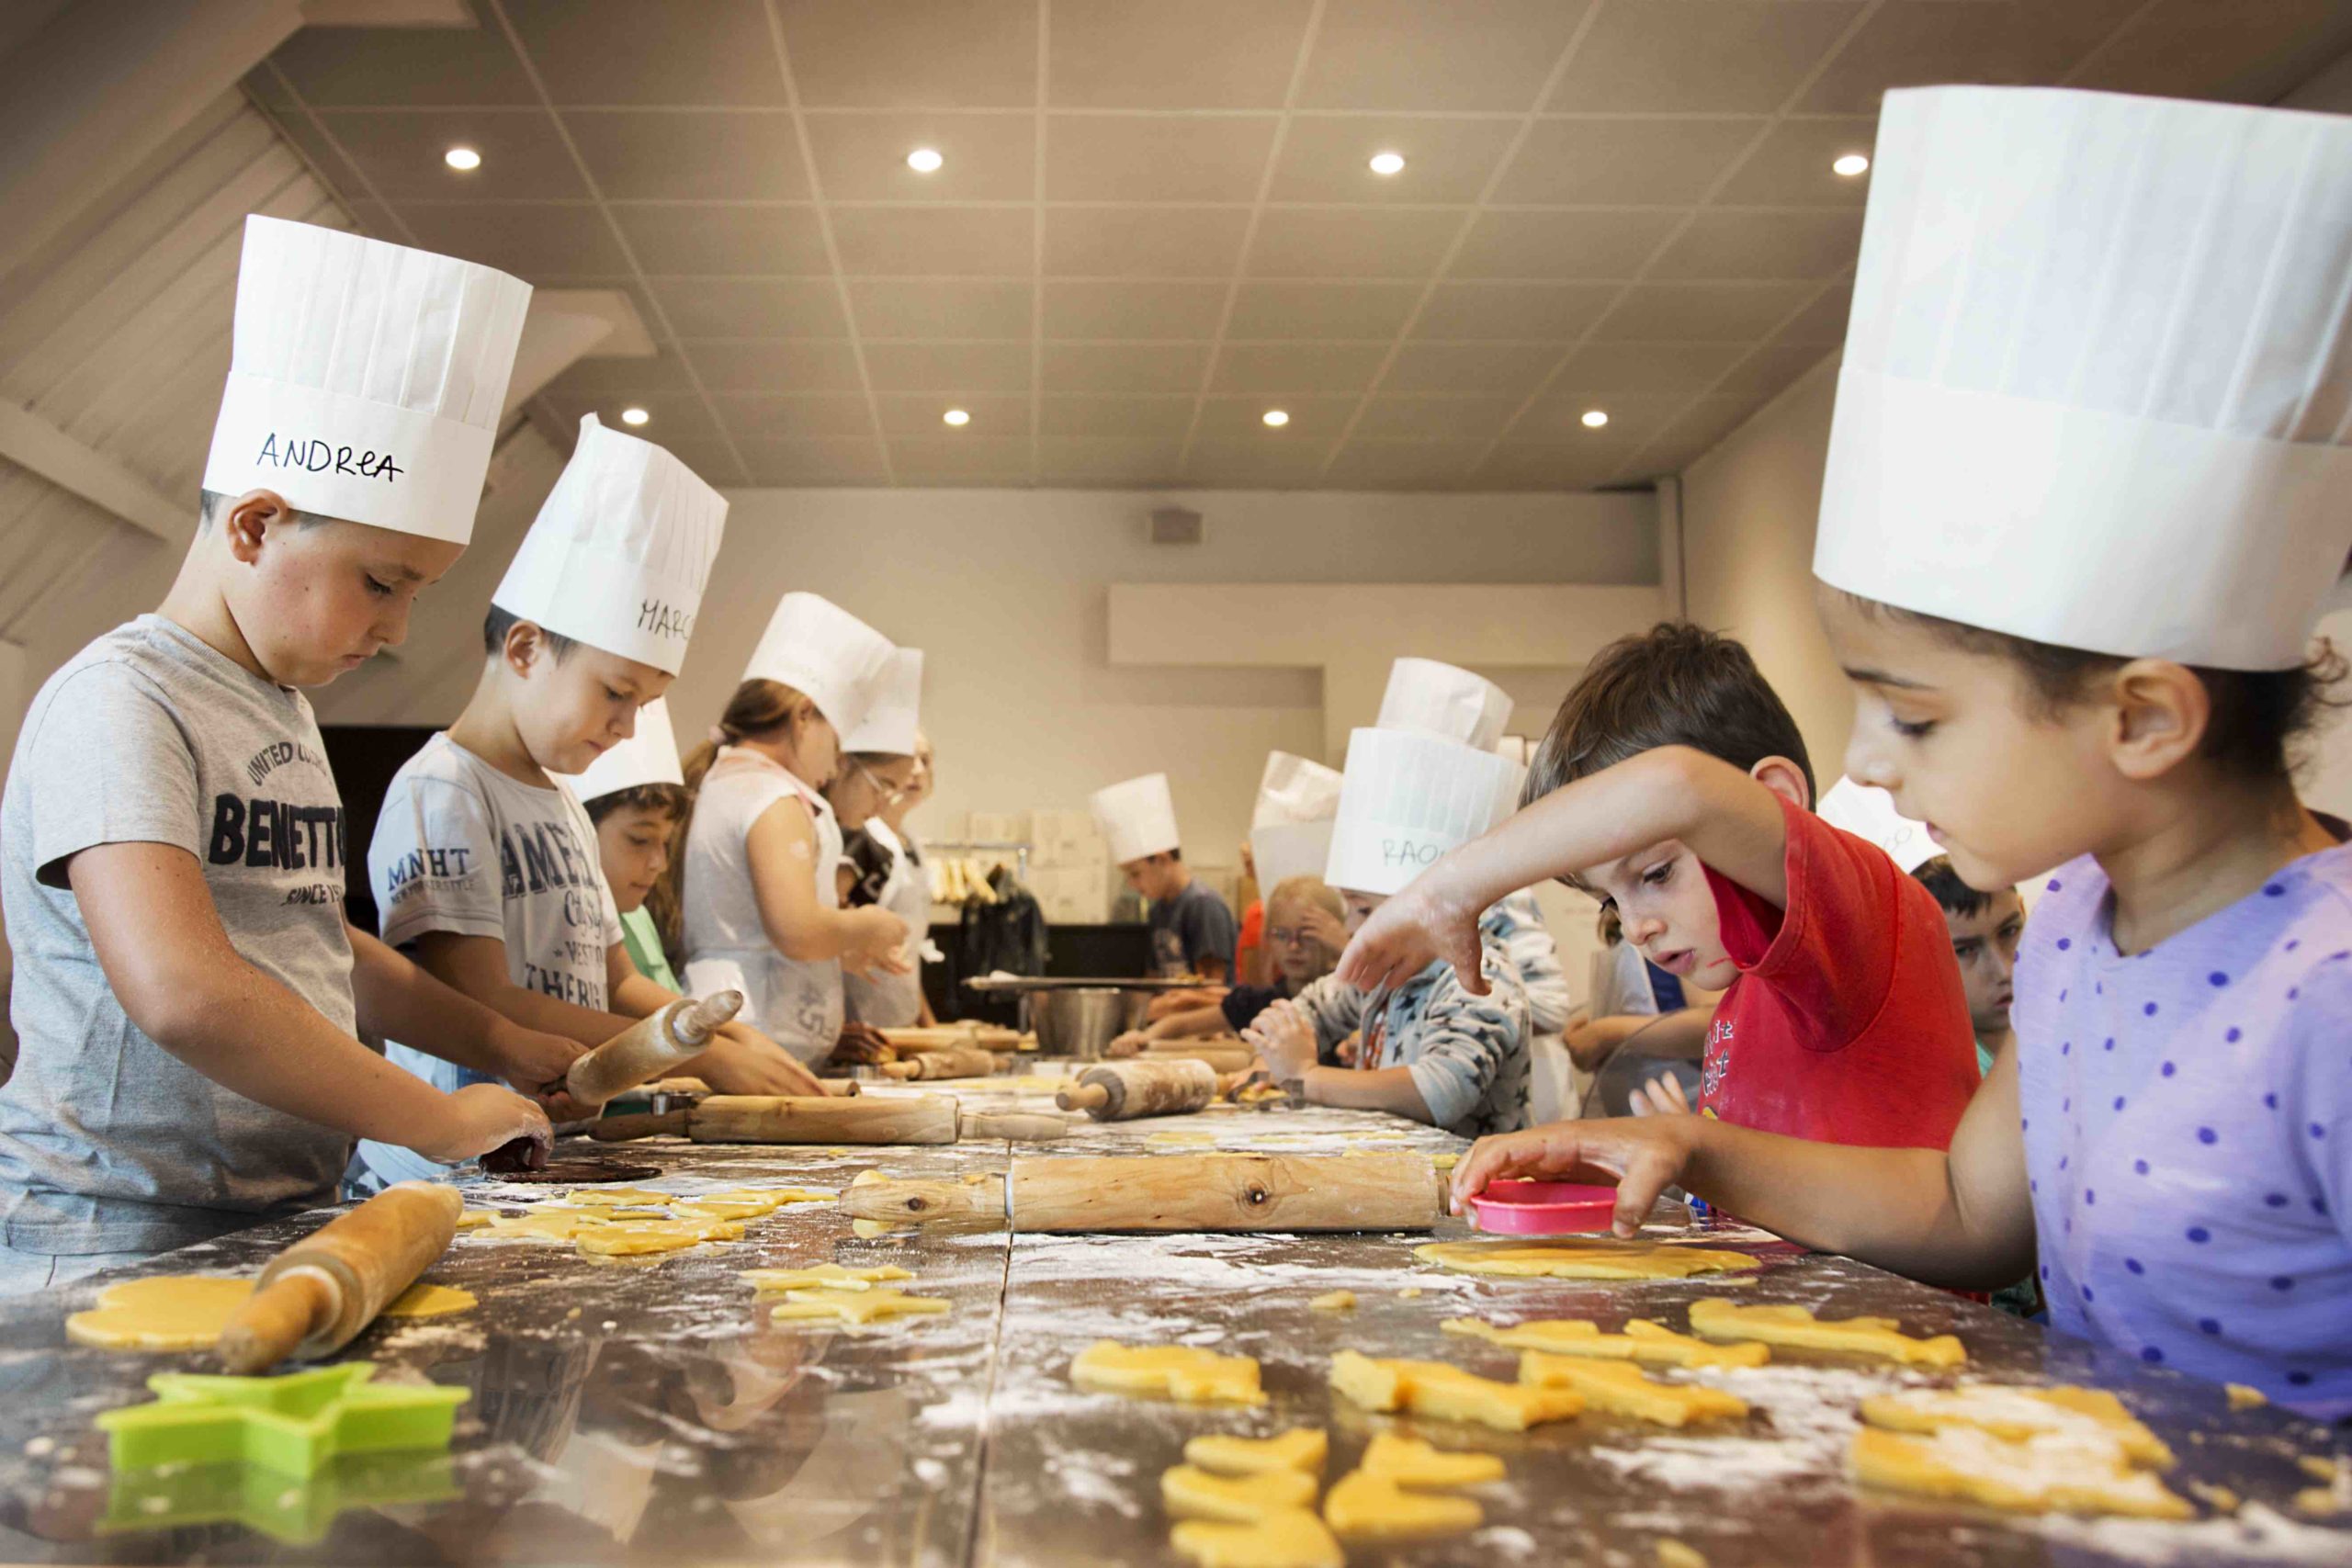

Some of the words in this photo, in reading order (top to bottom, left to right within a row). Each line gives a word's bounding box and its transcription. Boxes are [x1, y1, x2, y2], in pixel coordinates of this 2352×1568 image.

[247, 741, 293, 787] UNITED
[387, 848, 470, 891] MNHT
[1383, 839, 1446, 866] RAO
[281, 883, 326, 906] SINCE
